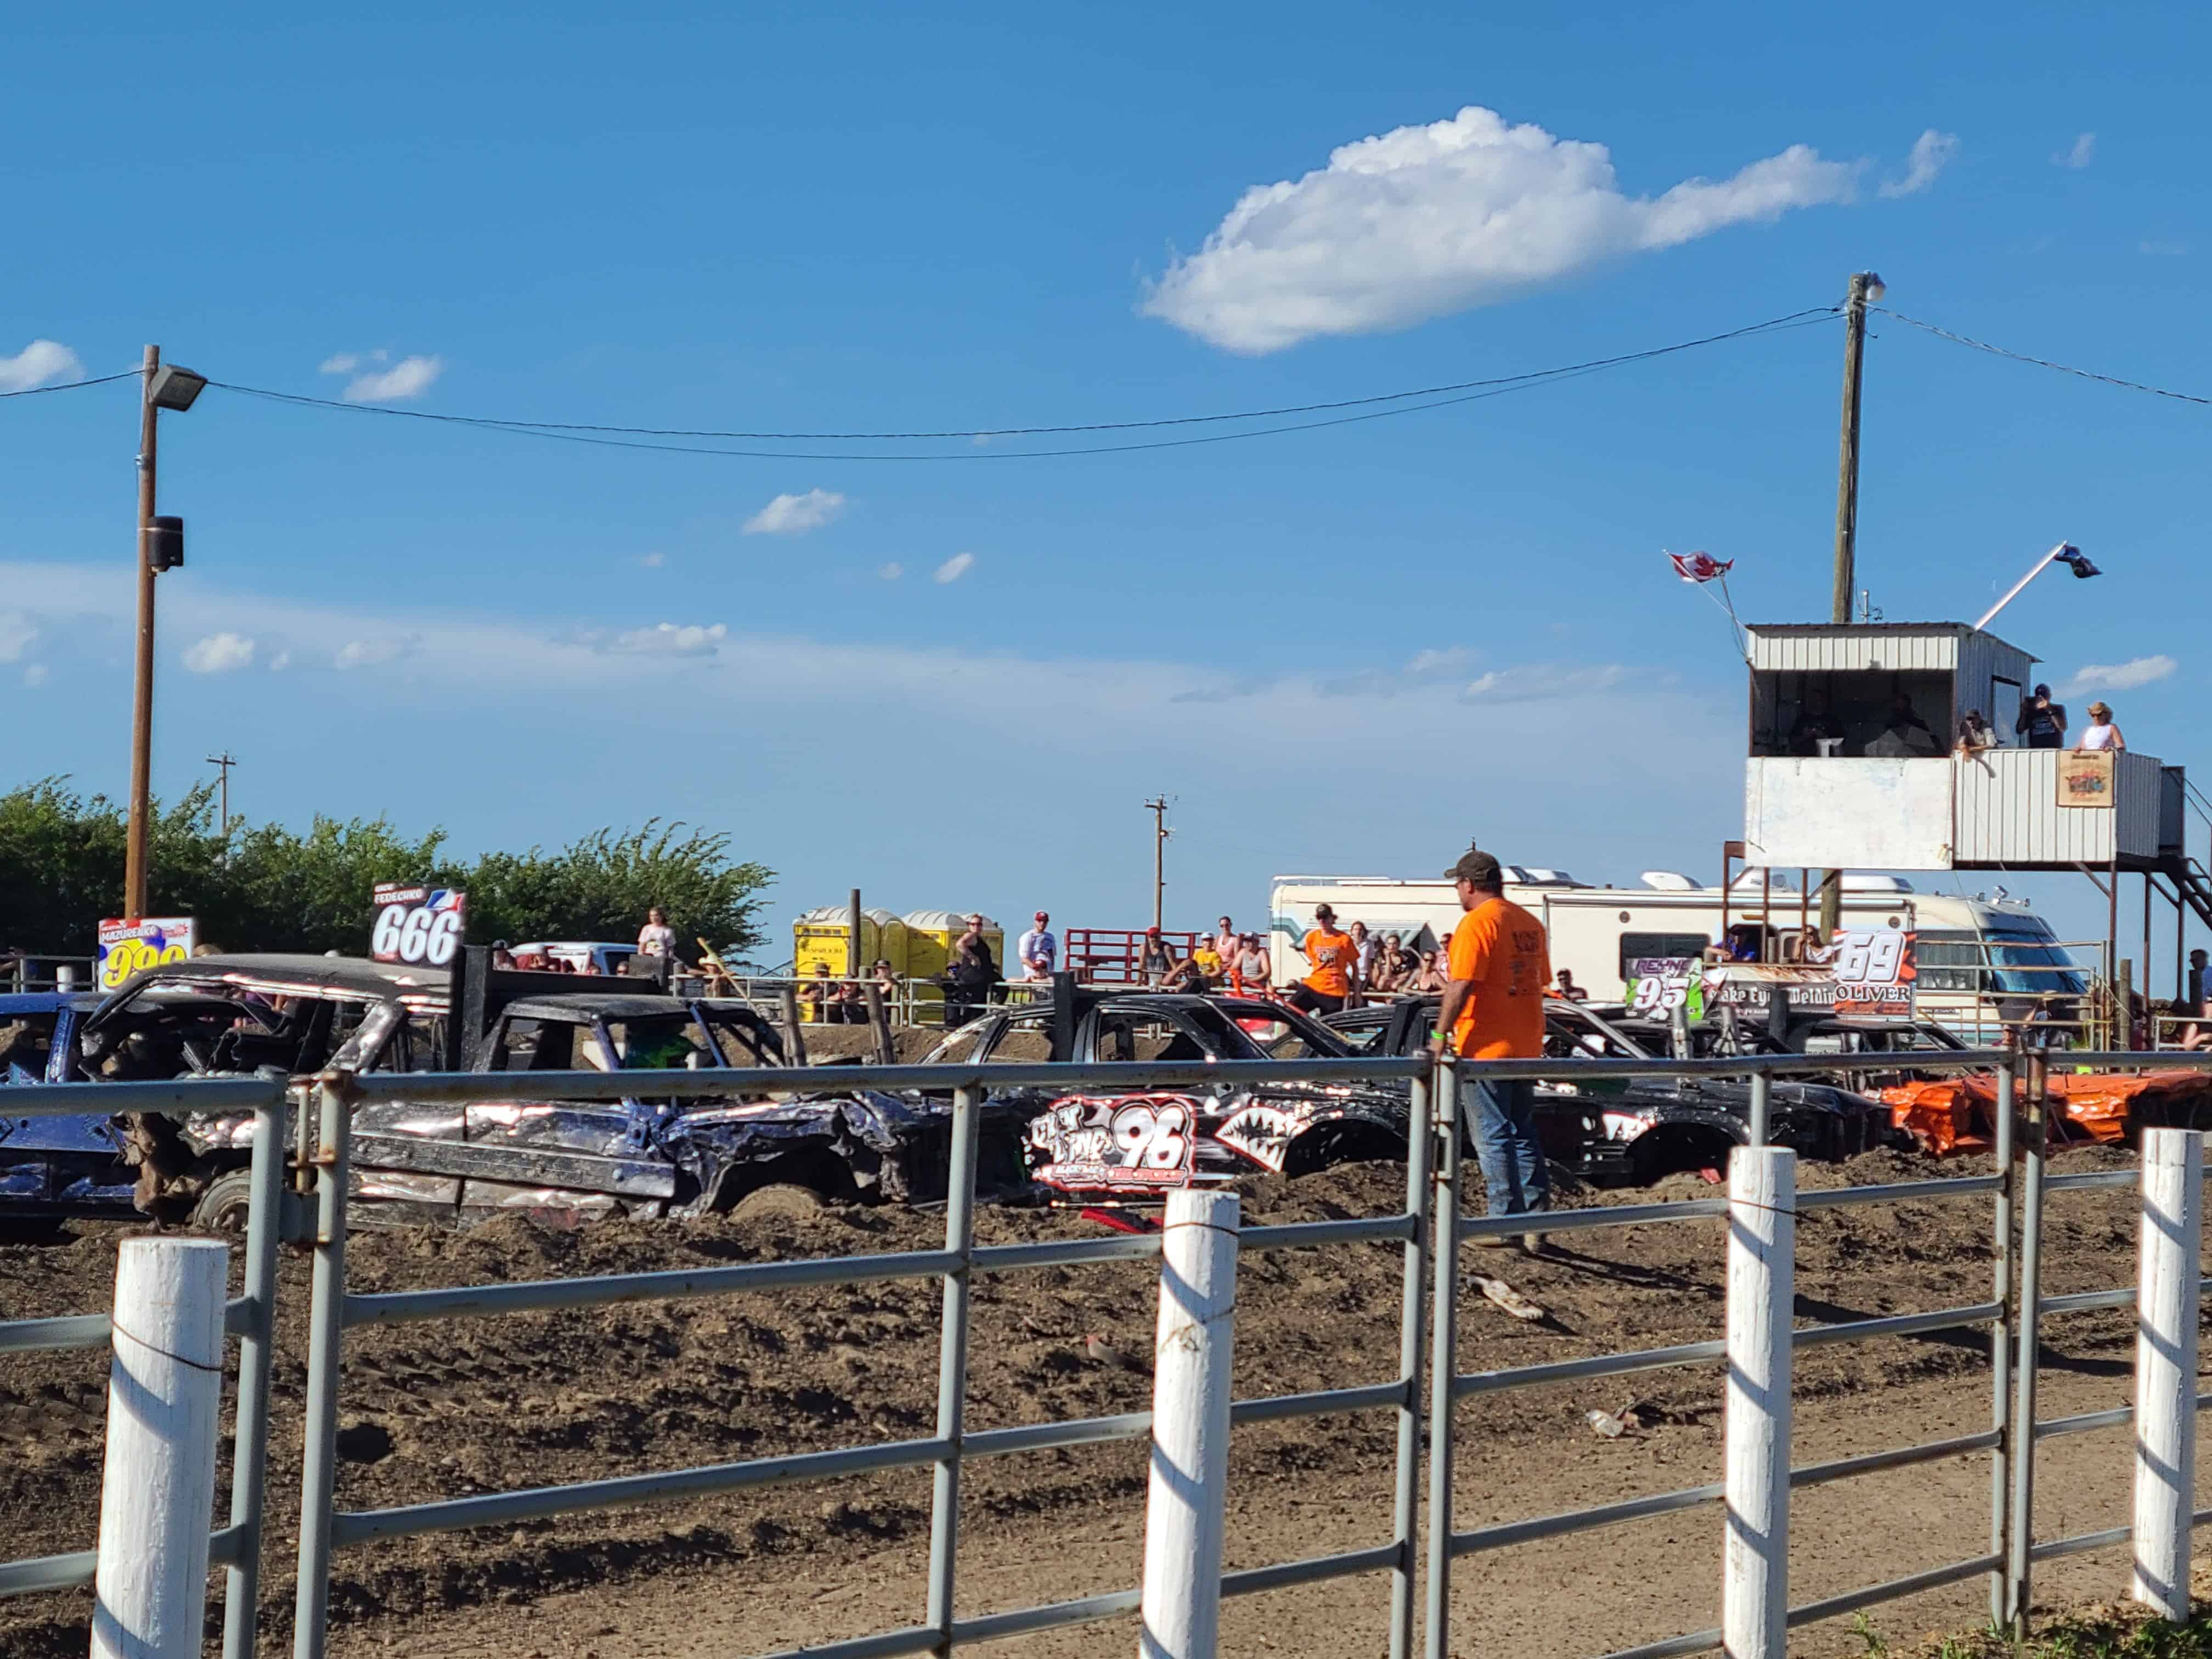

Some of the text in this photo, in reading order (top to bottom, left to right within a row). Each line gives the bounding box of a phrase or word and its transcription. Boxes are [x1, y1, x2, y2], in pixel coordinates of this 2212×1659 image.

[373, 904, 461, 965] 666
[1838, 932, 1904, 984] 69
[1836, 985, 1910, 1002] OLIVER
[1113, 1104, 1186, 1170] 96
